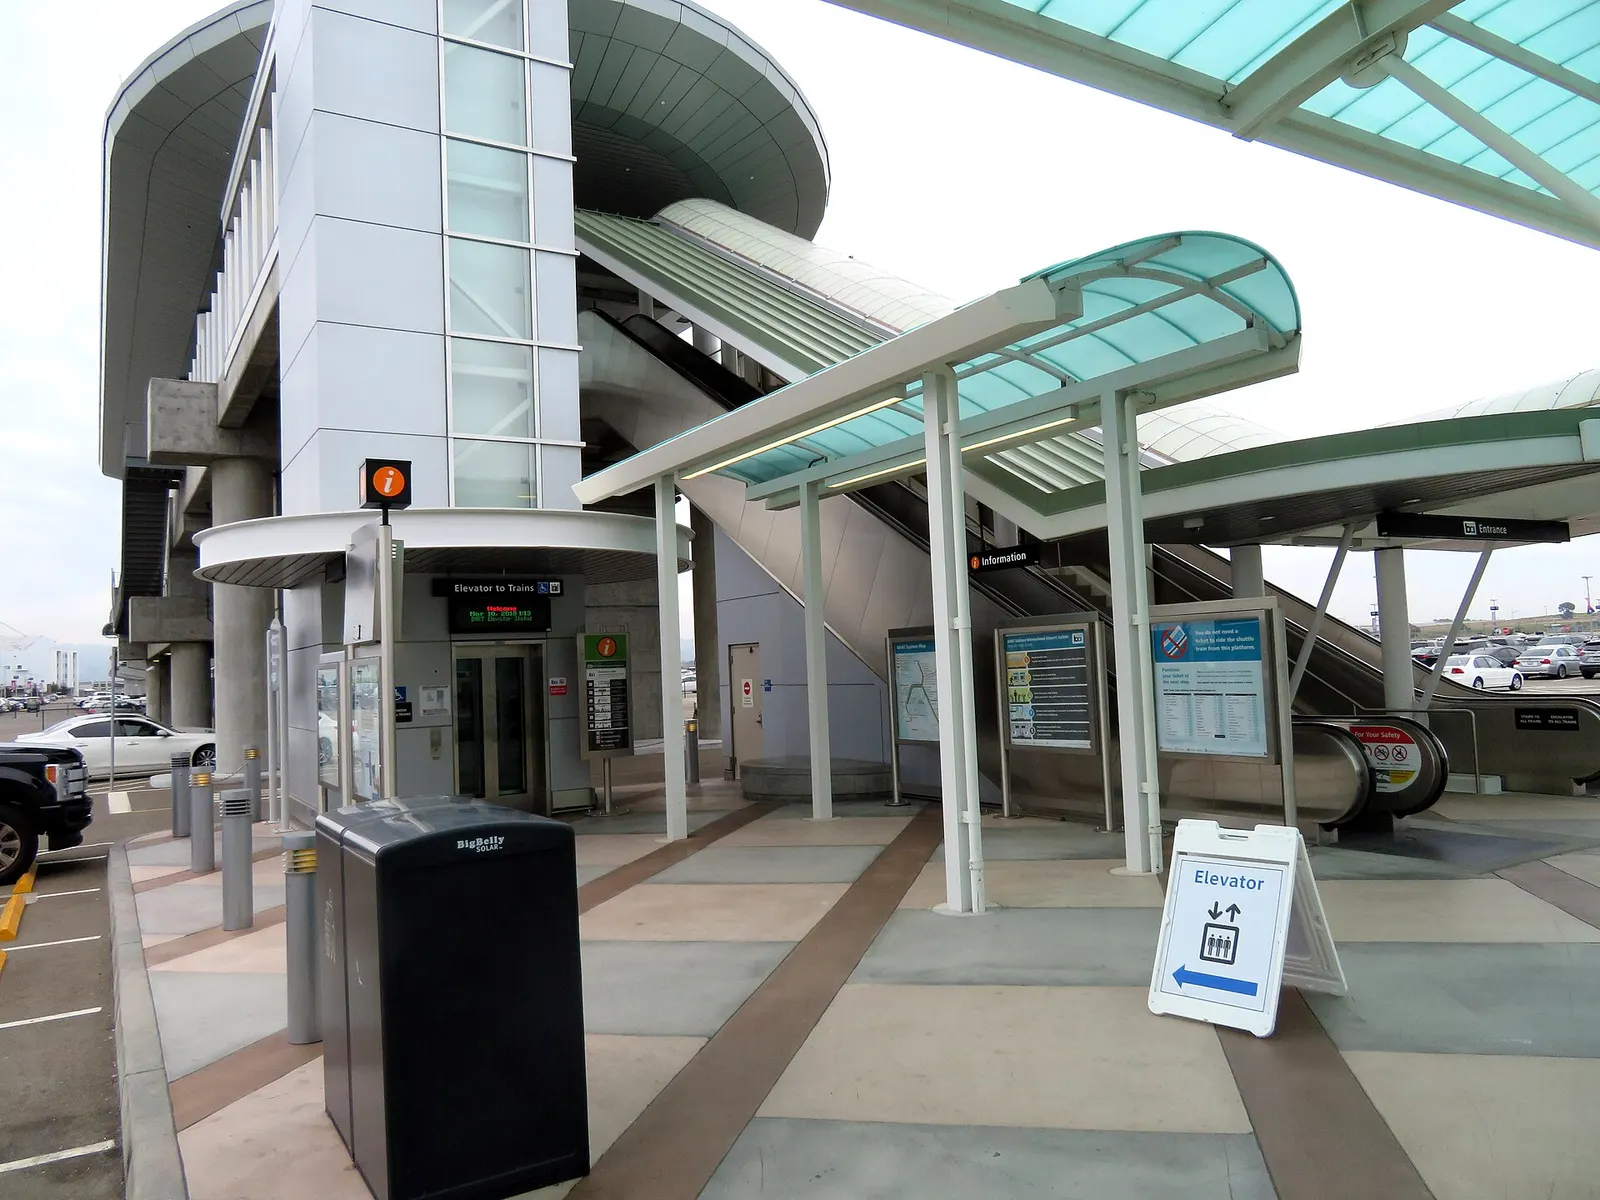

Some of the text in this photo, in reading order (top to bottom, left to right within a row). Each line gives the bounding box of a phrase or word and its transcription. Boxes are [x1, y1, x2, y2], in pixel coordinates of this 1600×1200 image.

[1479, 524, 1507, 534] Entrance
[981, 552, 1026, 566] Information
[454, 584, 493, 592] Elevator
[508, 584, 534, 592] Trains
[1381, 732, 1401, 740] Safety
[457, 836, 505, 849] BigBelly
[476, 844, 499, 853] SOLAR
[1194, 870, 1265, 890] Elevator
